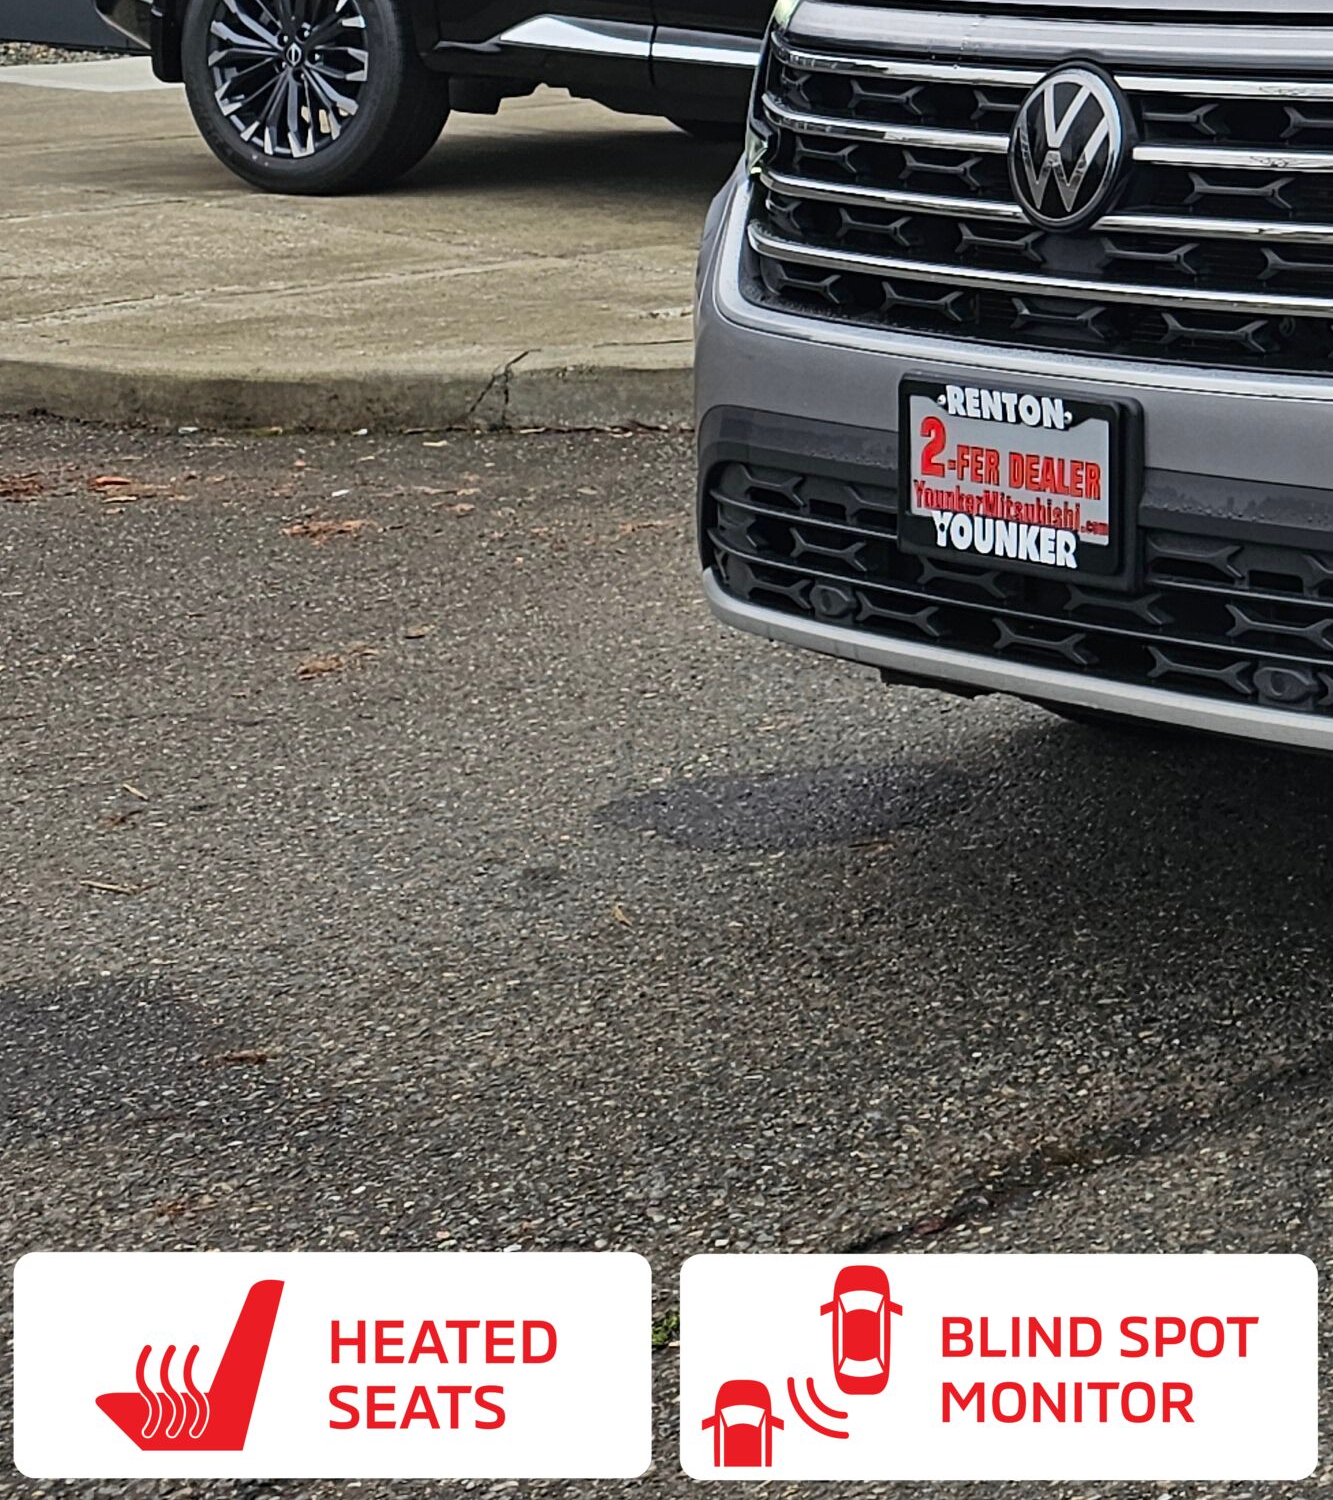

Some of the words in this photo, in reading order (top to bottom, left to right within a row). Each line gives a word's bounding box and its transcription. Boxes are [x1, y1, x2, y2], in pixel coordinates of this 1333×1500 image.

[945, 385, 1065, 430] RENTON
[920, 415, 1000, 486] 2-FER
[1008, 451, 1101, 501] DEALER
[931, 510, 1078, 570] YOUNKER
